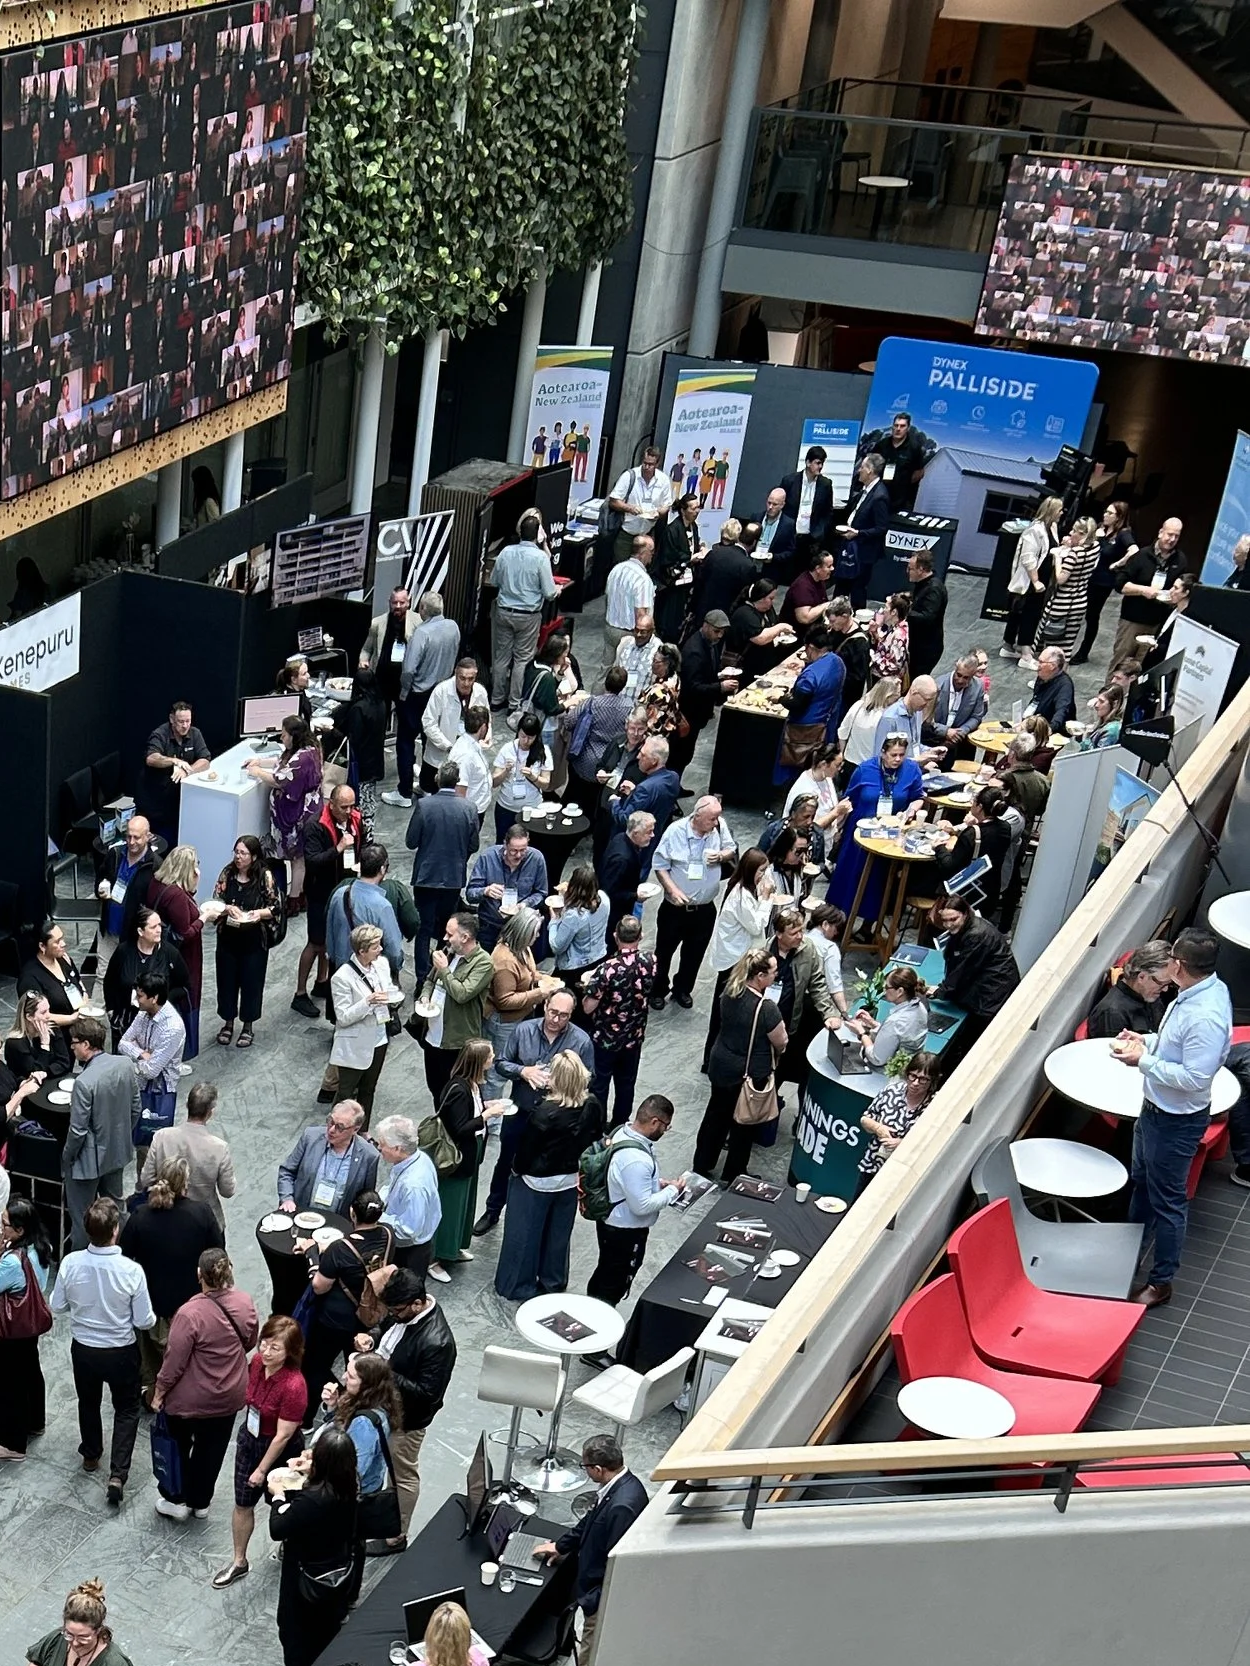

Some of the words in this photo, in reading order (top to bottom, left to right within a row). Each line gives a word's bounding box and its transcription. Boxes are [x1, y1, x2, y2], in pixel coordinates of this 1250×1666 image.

[932, 356, 969, 371] DYNEX
[928, 369, 1037, 401] PALLISIDE
[535, 397, 558, 406] New
[560, 391, 602, 404] Zealand
[675, 422, 699, 432] New
[700, 416, 743, 430] Zealand
[889, 533, 930, 550] DYNEX
[797, 1114, 828, 1165] ADE
